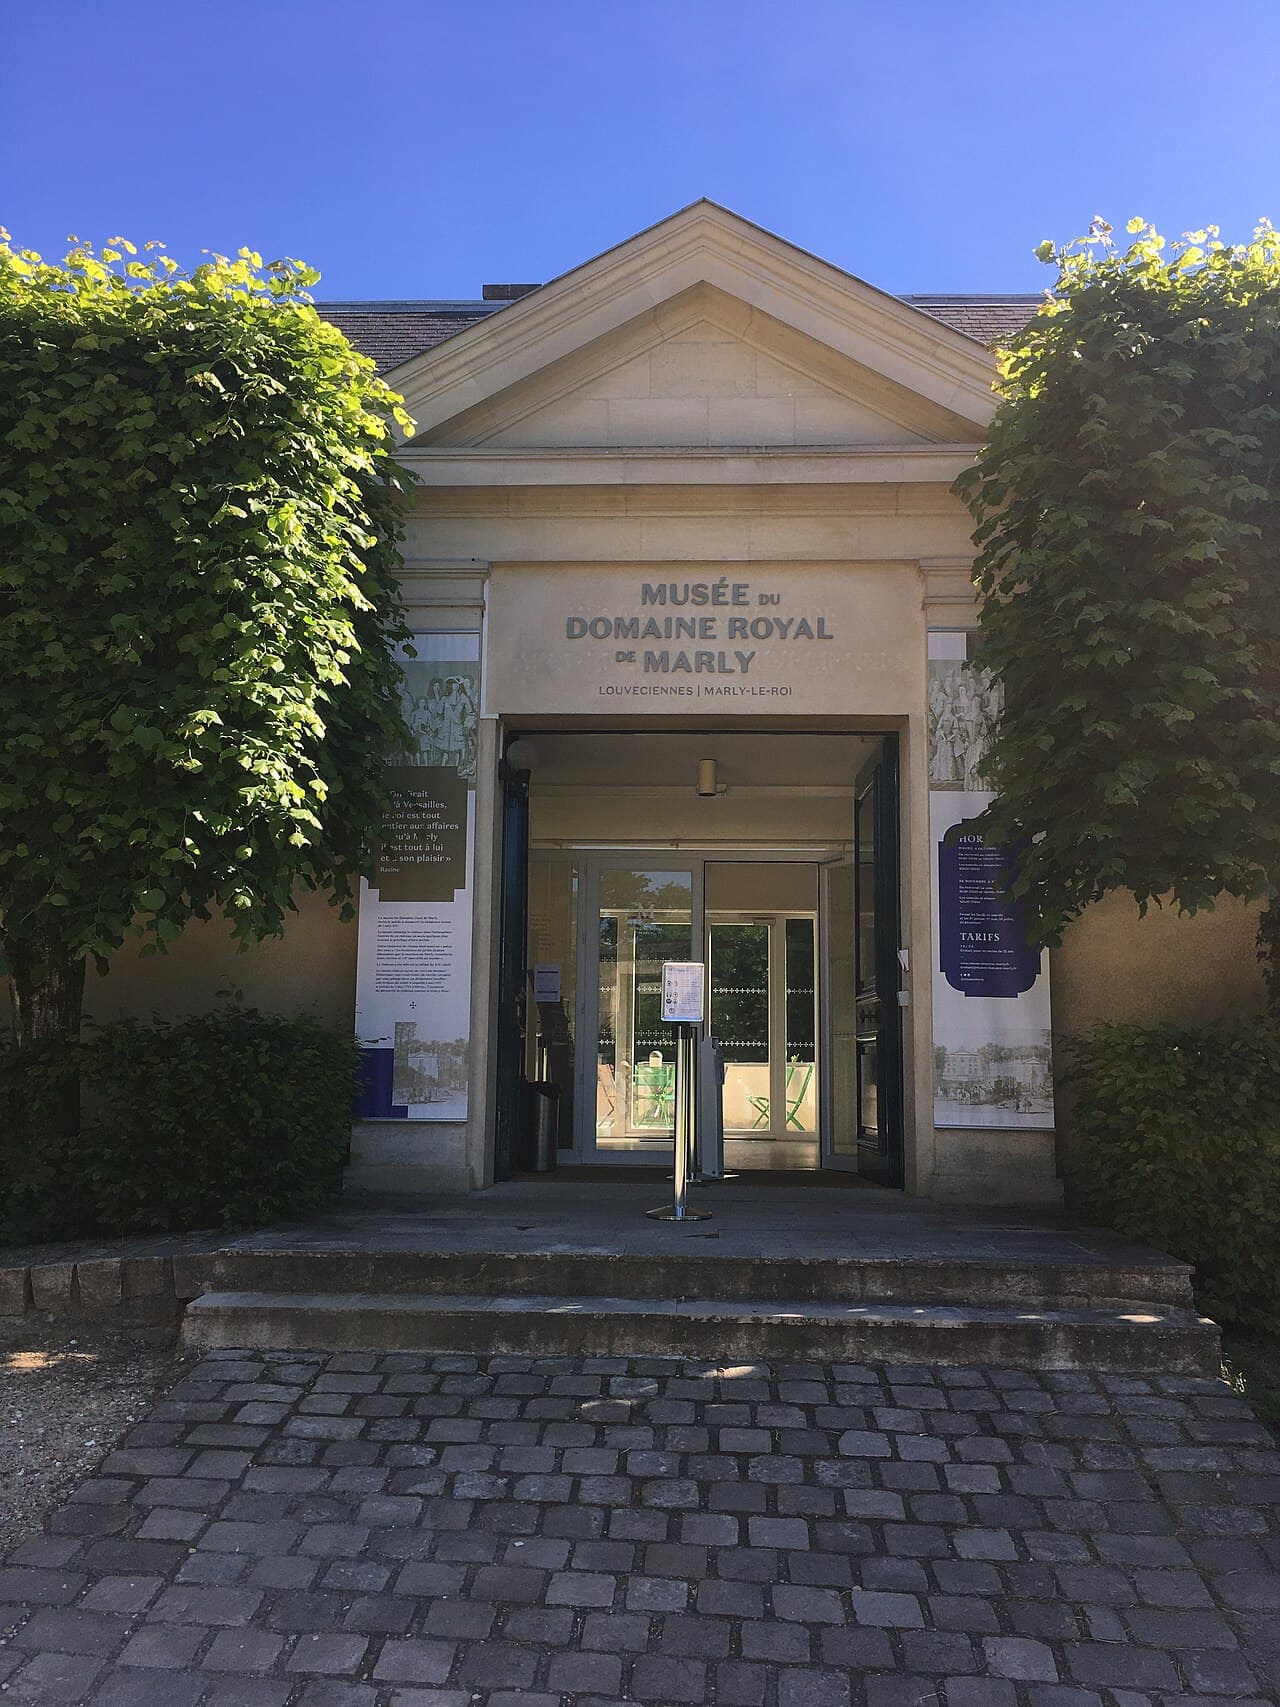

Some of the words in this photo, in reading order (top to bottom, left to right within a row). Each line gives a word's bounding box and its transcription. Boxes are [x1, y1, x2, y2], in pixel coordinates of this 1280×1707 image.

[641, 577, 750, 606] MUSÉE
[758, 593, 781, 605] DU
[566, 616, 717, 639] DOMAINE
[728, 616, 834, 639] ROYAL
[615, 651, 637, 662] DE
[643, 650, 756, 673] MARLY
[600, 686, 693, 696] LOUVECIENNES
[704, 686, 792, 696] MARLY-LE-ROI
[427, 821, 460, 830] affaires
[432, 843, 445, 851] lui
[380, 854, 391, 862] et
[416, 854, 445, 864] plaisir
[960, 932, 1001, 942] TARIFS
